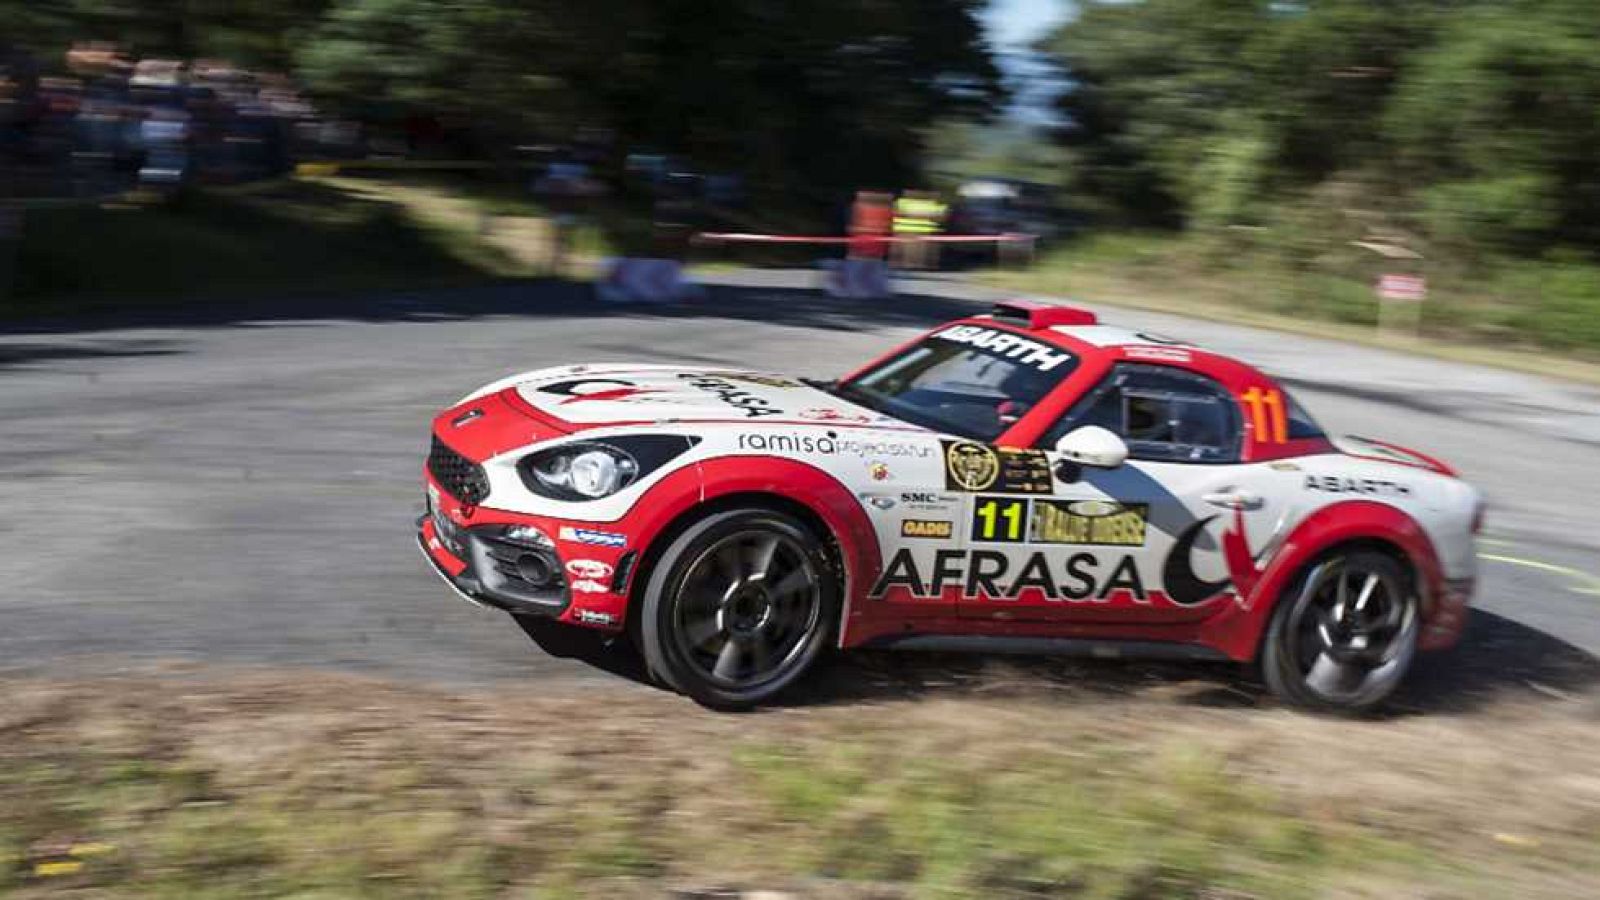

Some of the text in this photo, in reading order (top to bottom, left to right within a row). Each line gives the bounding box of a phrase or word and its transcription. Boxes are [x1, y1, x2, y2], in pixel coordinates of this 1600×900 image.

[933, 325, 1071, 371] ABARTH
[1241, 386, 1287, 444] 11
[738, 431, 836, 455] ramisa
[900, 491, 937, 503] SMC
[1304, 474, 1411, 494] ABARTH
[977, 500, 1021, 540] 11
[870, 548, 1147, 601] AFRASA
